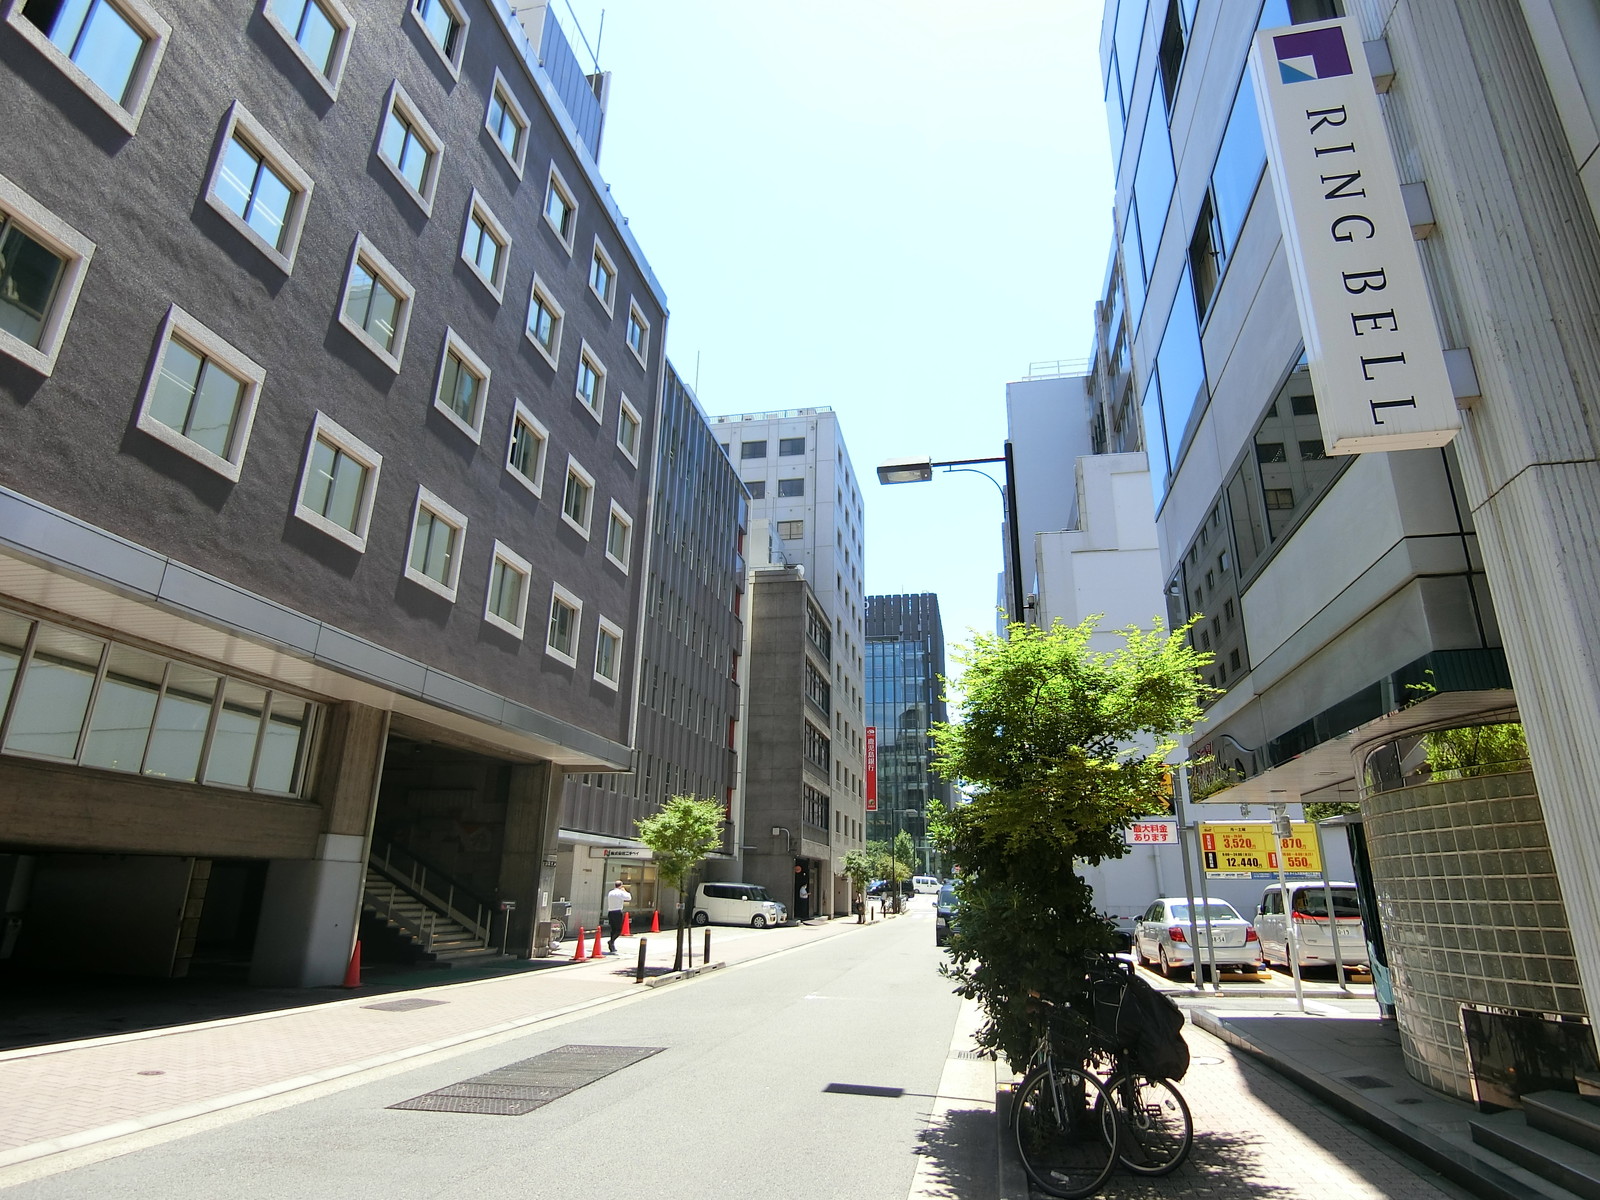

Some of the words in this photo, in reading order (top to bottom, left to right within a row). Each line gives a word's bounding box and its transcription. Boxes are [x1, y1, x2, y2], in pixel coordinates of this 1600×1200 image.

[1133, 824, 1168, 833] 最大料金
[1134, 833, 1168, 842] あります
